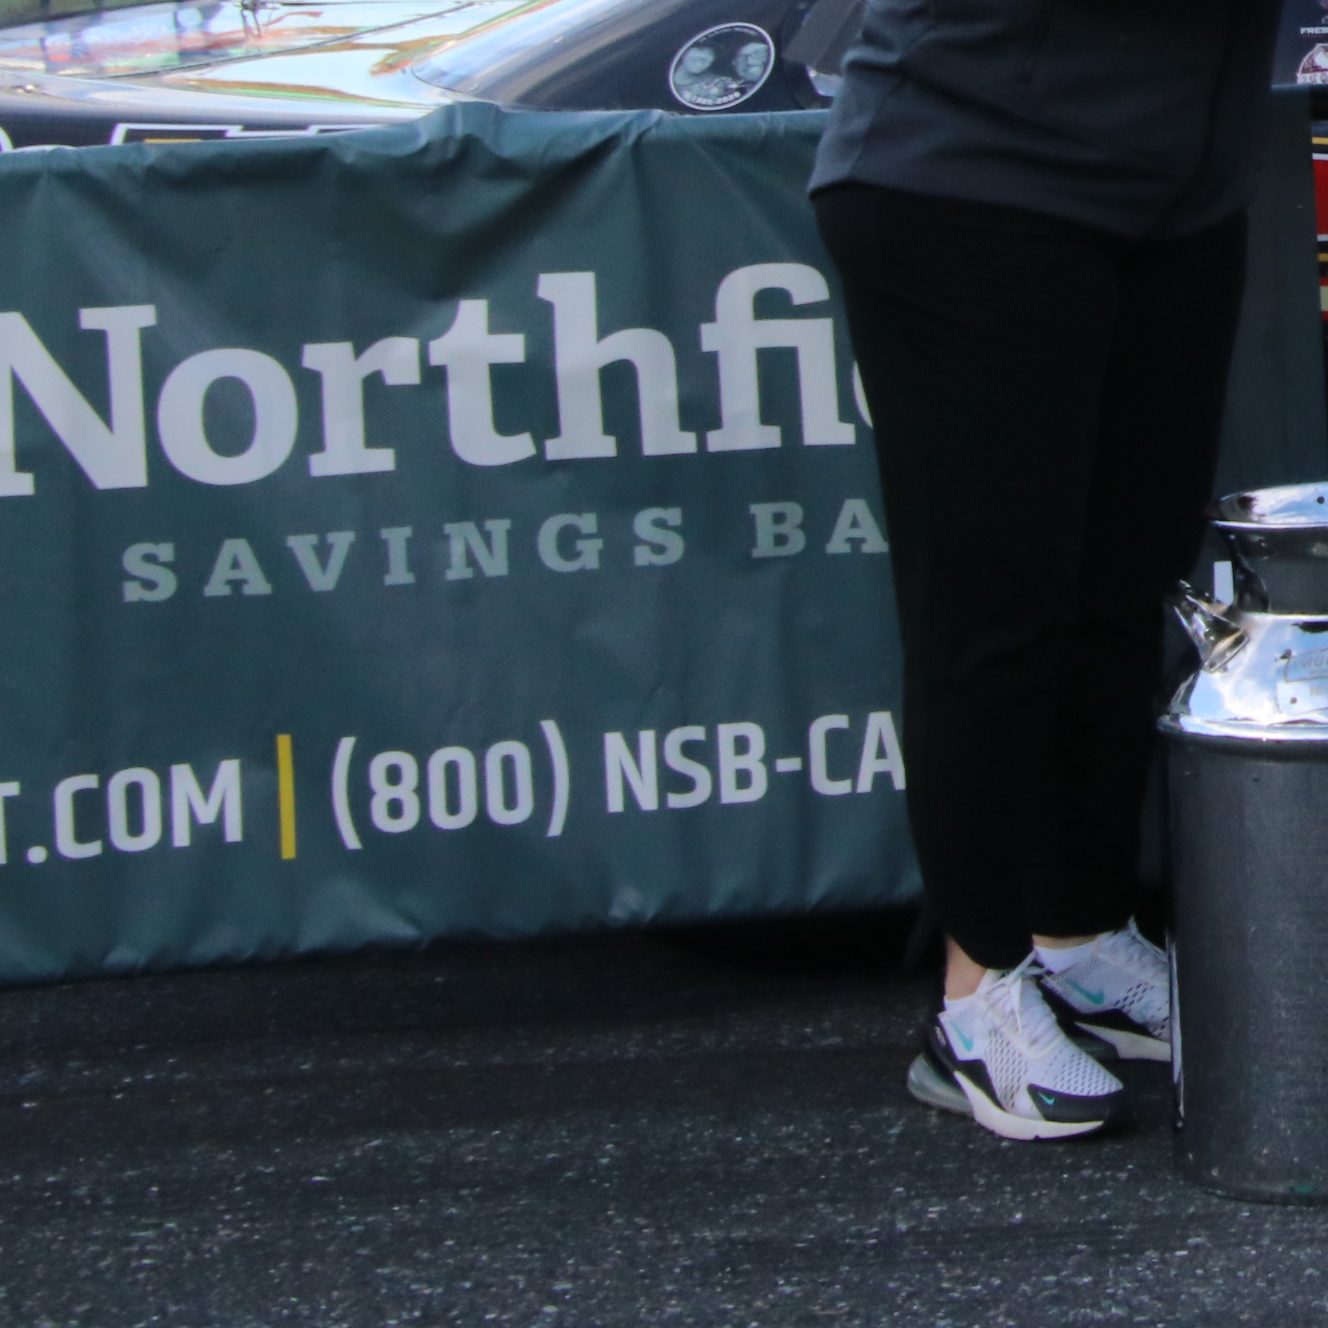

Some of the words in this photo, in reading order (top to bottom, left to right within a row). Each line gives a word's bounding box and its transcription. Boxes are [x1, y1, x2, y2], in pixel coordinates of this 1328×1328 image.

[0, 262, 876, 497] Northfi
[121, 507, 686, 604] SAVINGS
[750, 498, 890, 559] BA
[331, 719, 572, 851] (800)
[604, 711, 909, 814] NSB-CA
